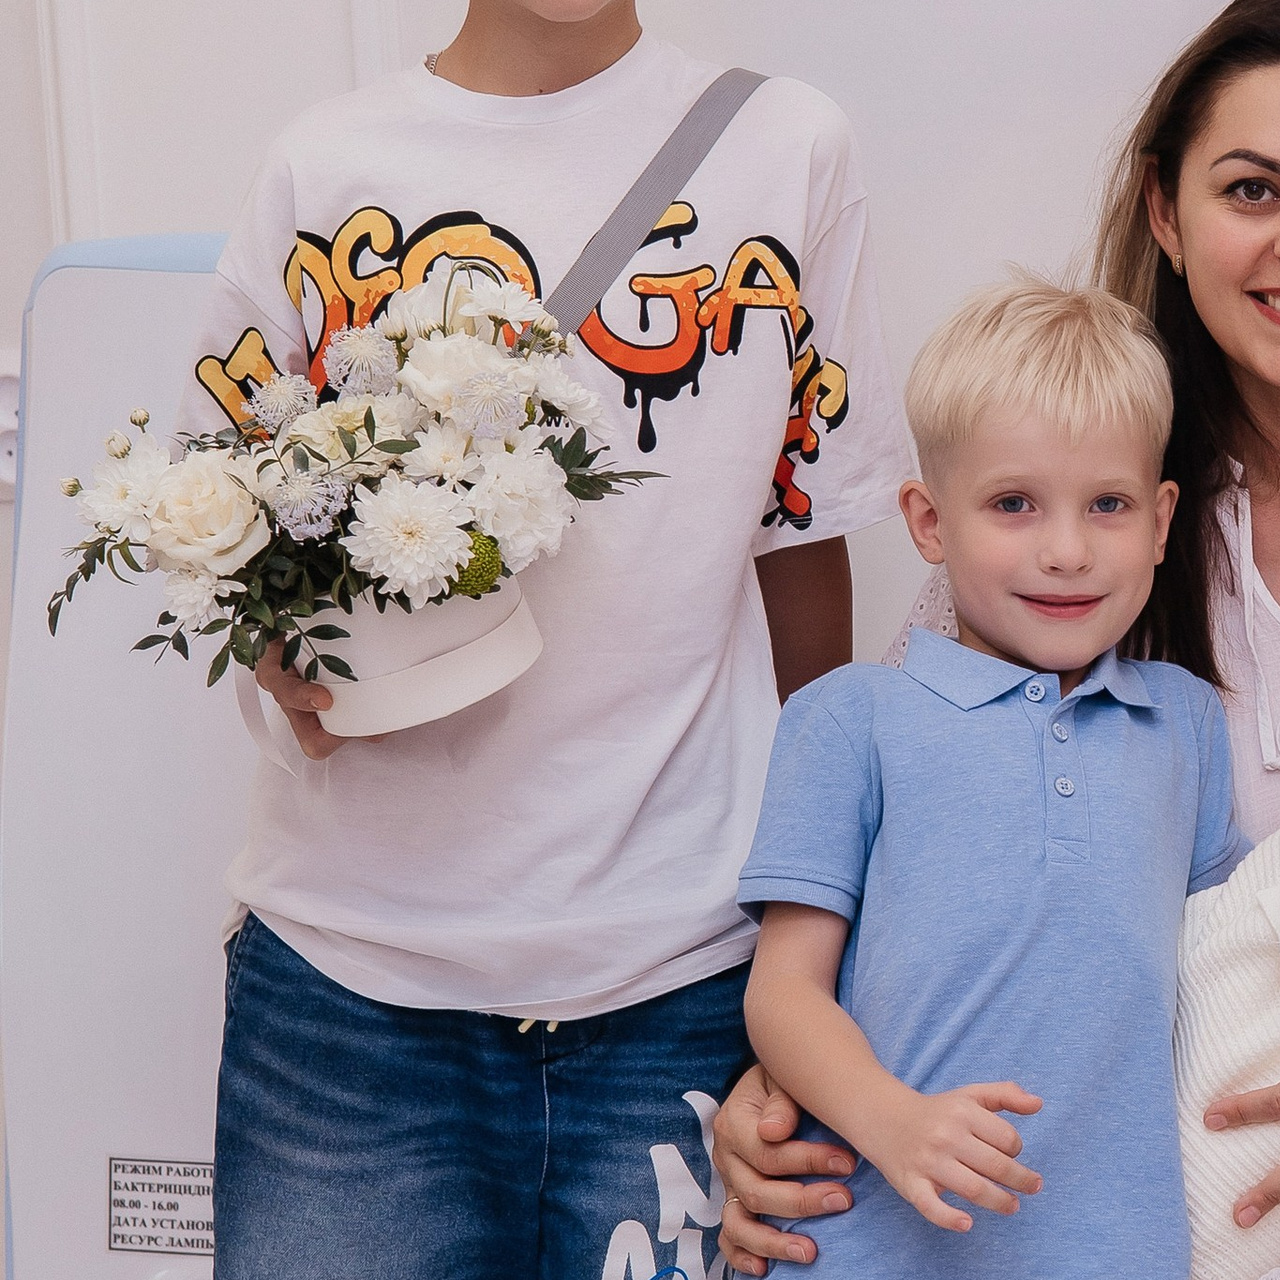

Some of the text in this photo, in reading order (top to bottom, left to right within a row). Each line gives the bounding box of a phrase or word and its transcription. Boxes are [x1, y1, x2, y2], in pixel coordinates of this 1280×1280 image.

[113, 1163, 162, 1176] РЕЖИМ
[113, 1180, 214, 1196] БАКТЕРИЦИДН
[112, 1198, 141, 1210] 08.00
[152, 1200, 179, 1211] 16.00
[112, 1215, 147, 1228] ДАТА
[113, 1233, 163, 1247] РЕСУРС
